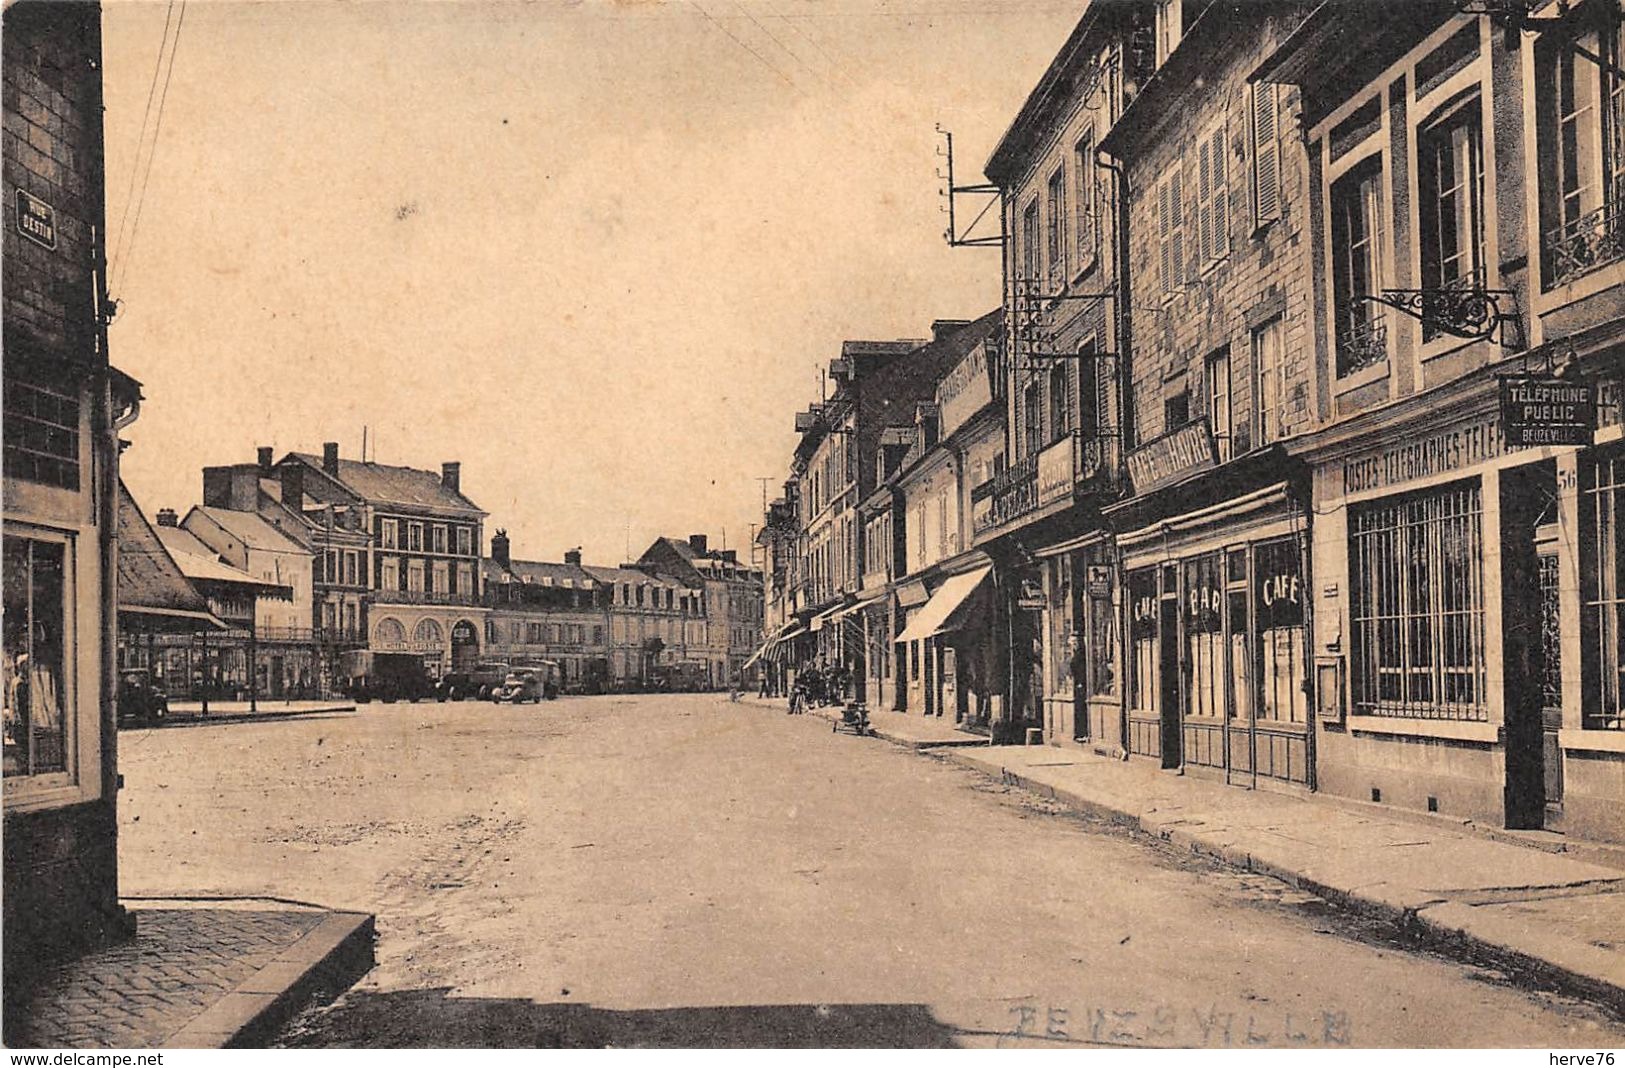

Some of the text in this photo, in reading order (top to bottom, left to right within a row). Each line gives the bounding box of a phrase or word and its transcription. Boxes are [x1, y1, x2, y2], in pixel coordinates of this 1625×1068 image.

[1524, 405, 1575, 420] PUBLIC
[1167, 424, 1211, 472] HAVRE
[1190, 586, 1220, 616] BAR
